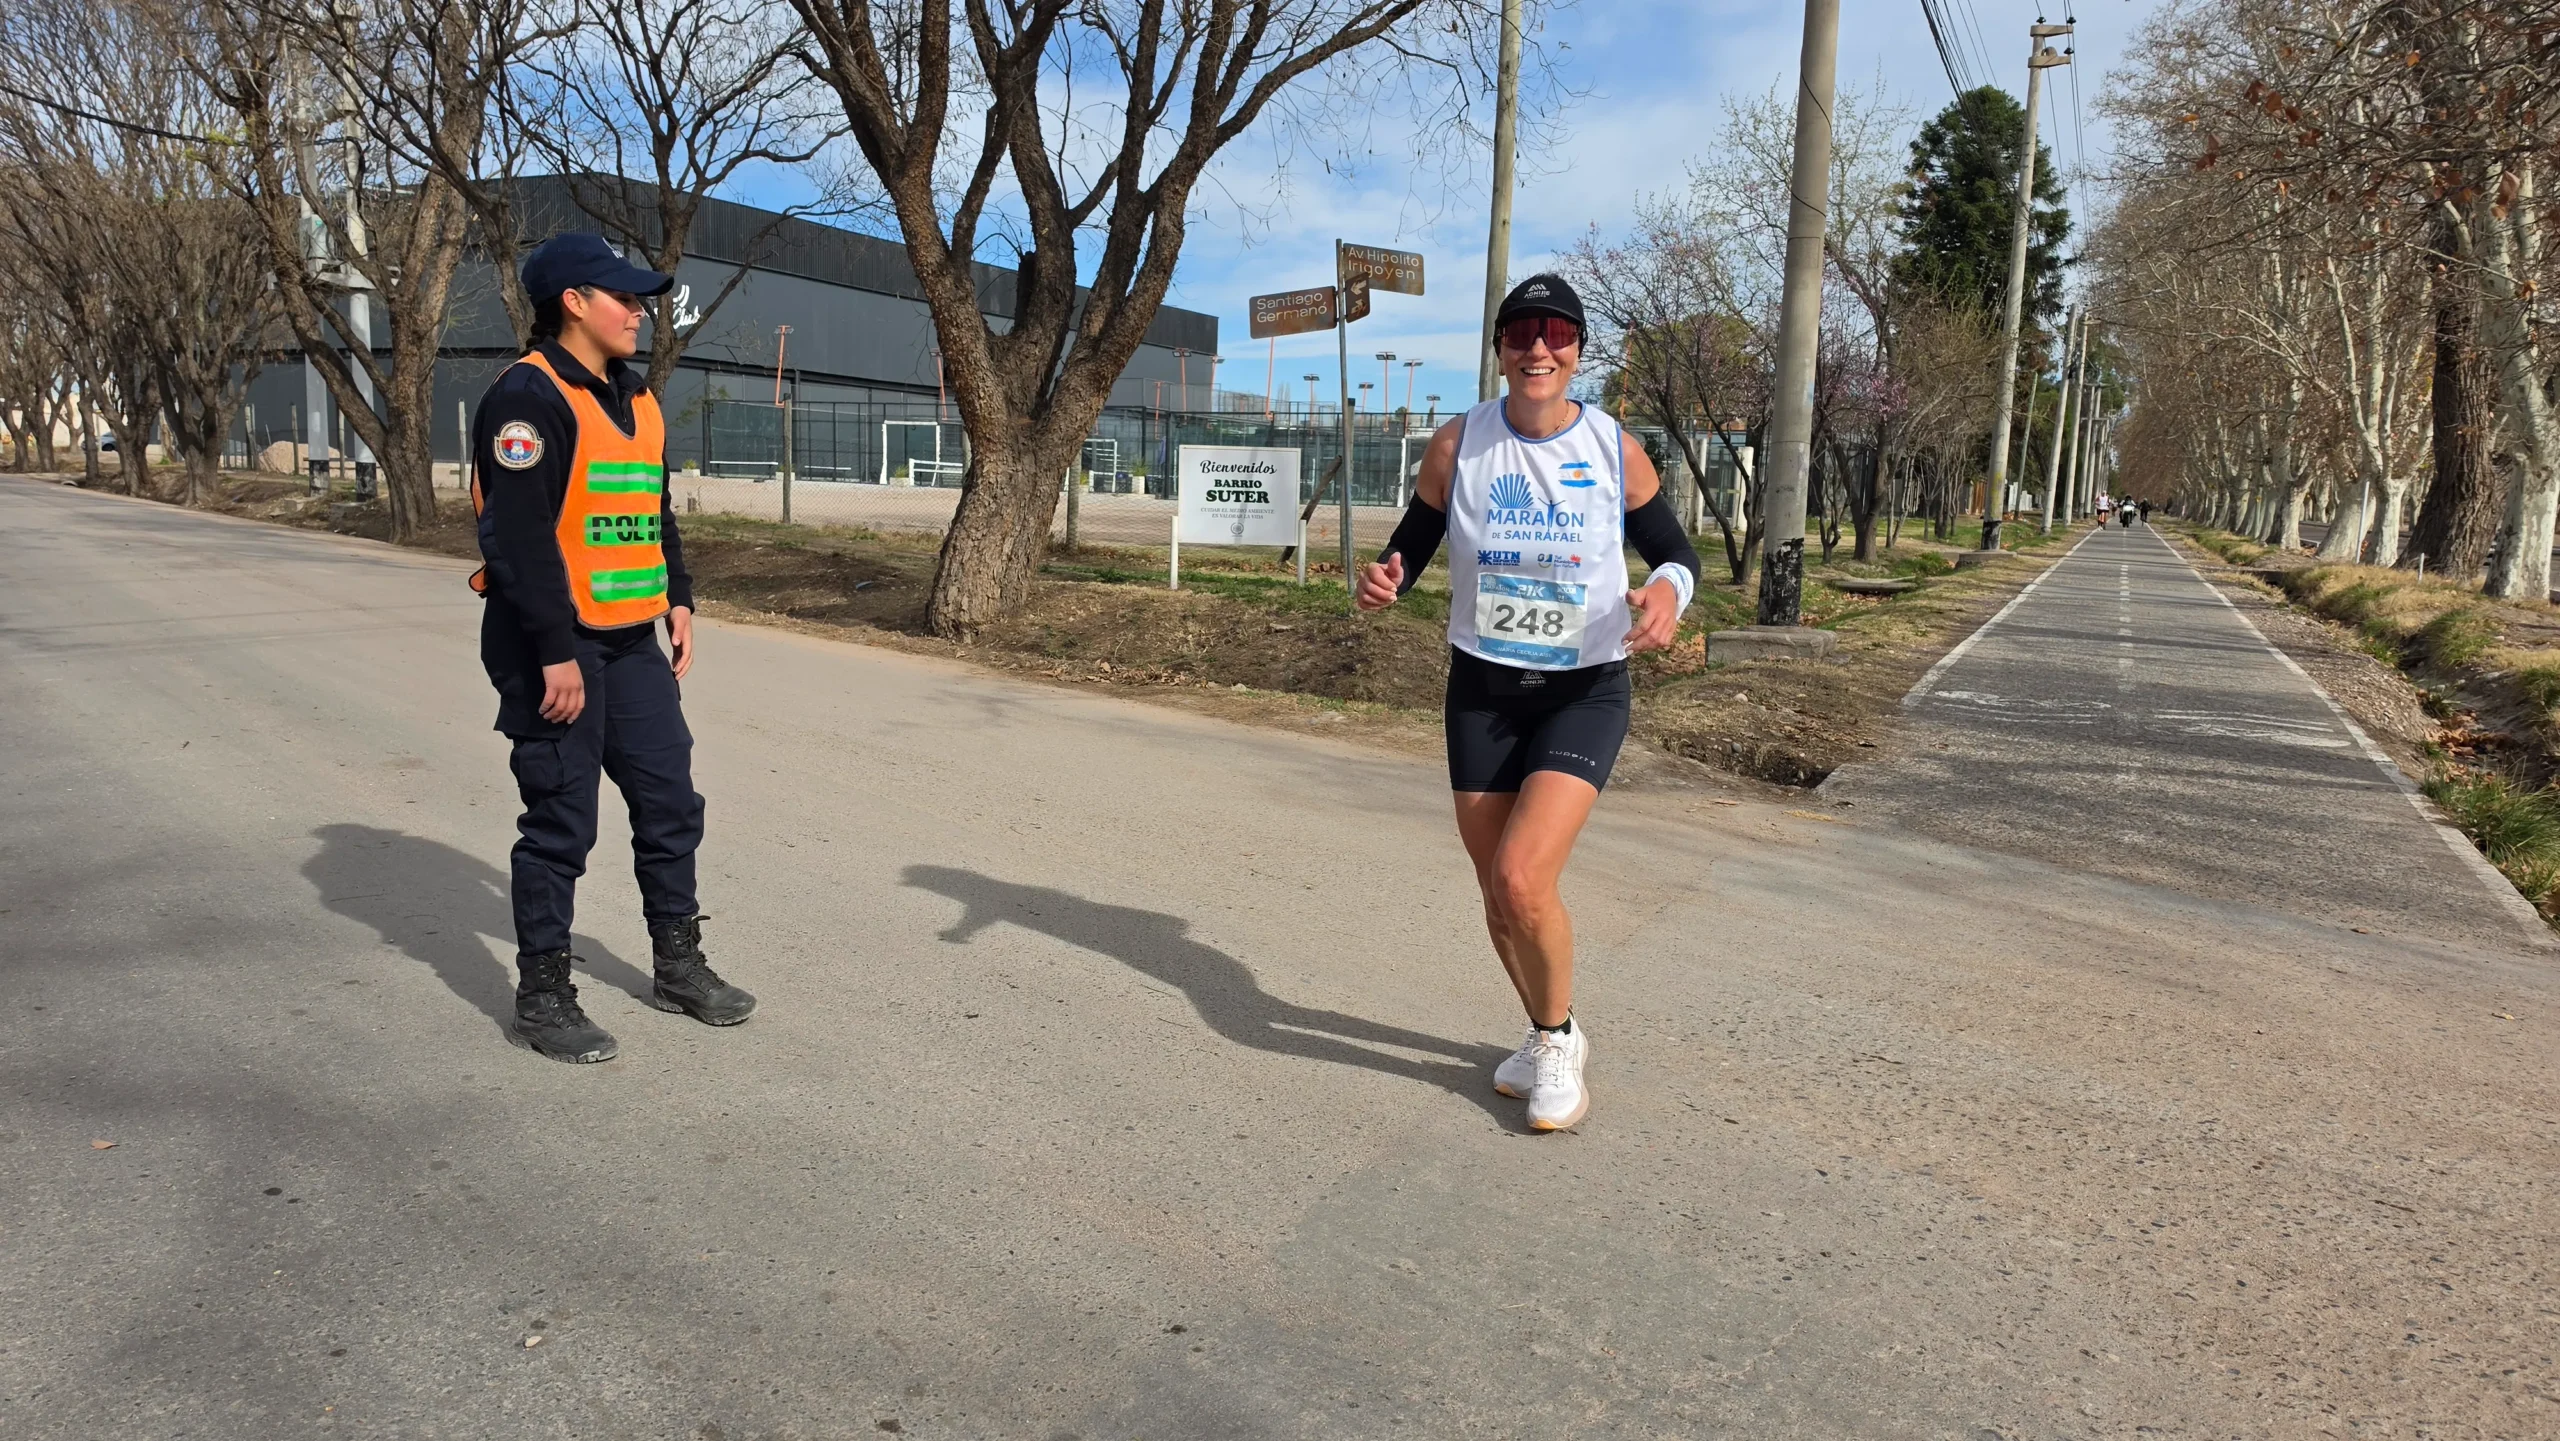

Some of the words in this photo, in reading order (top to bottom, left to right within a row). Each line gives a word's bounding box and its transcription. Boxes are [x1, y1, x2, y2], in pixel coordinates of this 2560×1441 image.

[1367, 249, 1420, 267] Hipolito
[1348, 260, 1416, 280] Irigoyen
[1256, 292, 1324, 310] Santiago
[673, 305, 701, 330] Club
[1256, 301, 1328, 323] Germanó
[1200, 460, 1278, 475] Bienvenidos
[1214, 479, 1262, 489] BARRIO
[1205, 490, 1270, 504] SUTER
[1504, 530, 1532, 541] SAN
[1534, 531, 1583, 543] RAFAEL
[1493, 550, 1521, 560] UTN
[1516, 584, 1546, 598] 21K
[1493, 604, 1564, 637] 248
